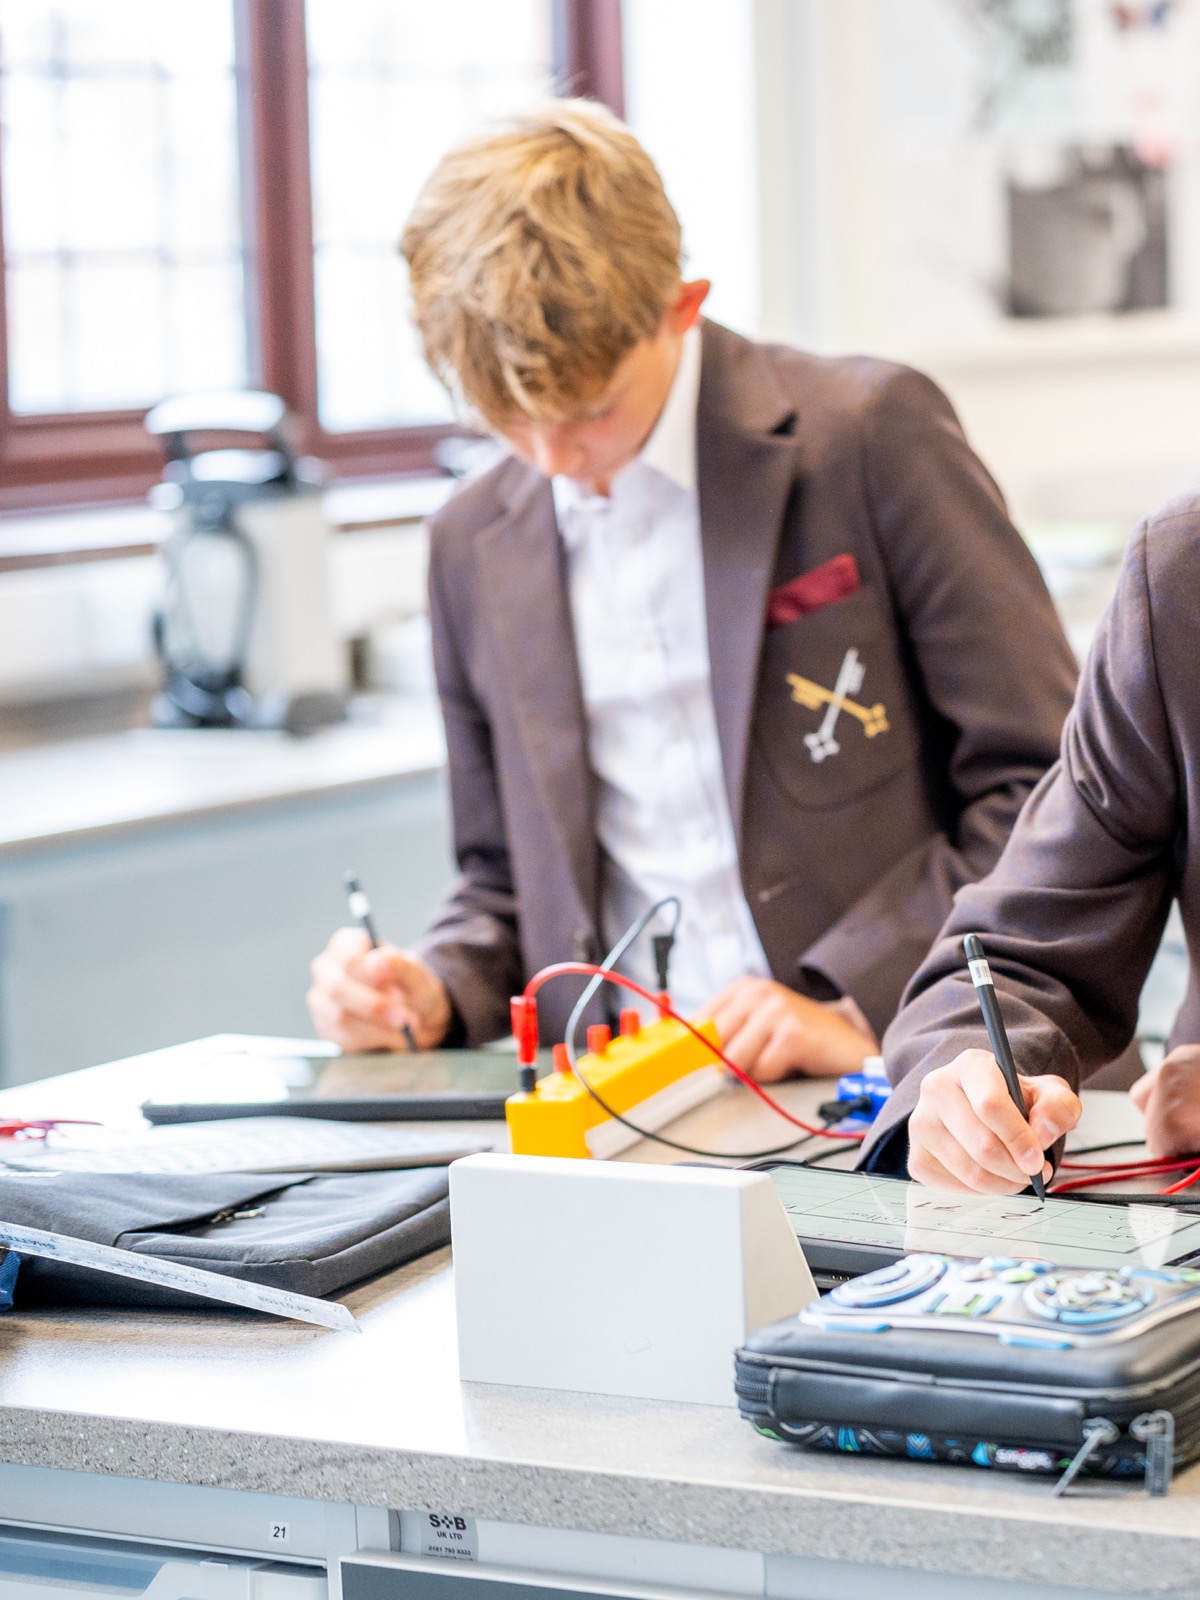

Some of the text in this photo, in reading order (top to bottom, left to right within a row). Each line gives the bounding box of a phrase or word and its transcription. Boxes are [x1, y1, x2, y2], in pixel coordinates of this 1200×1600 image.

[273, 1525, 286, 1539] 21
[436, 1531, 463, 1541] UK LTD
